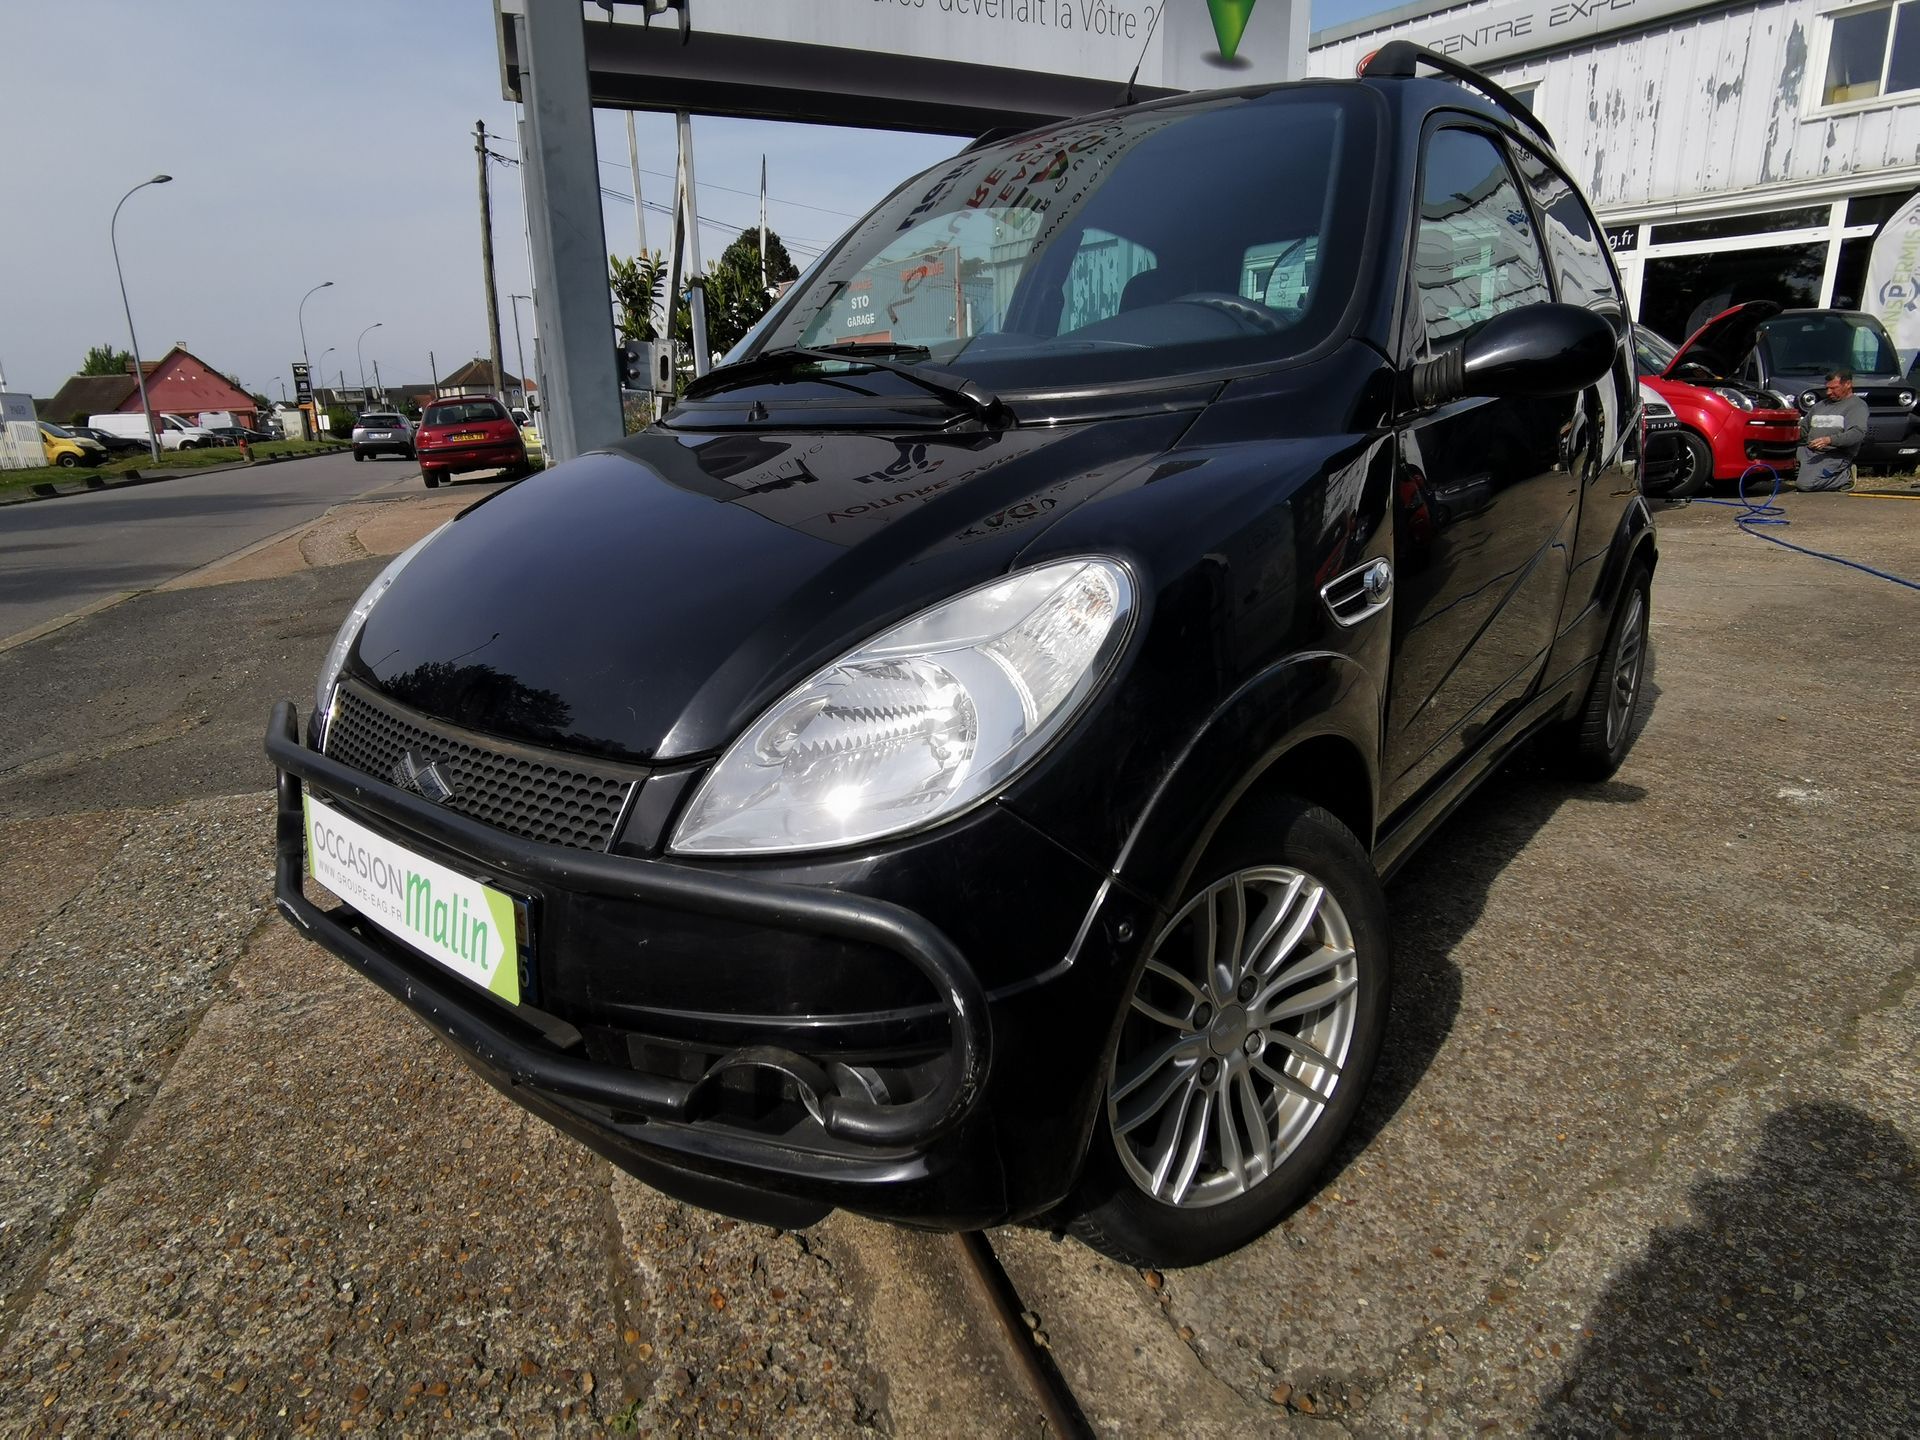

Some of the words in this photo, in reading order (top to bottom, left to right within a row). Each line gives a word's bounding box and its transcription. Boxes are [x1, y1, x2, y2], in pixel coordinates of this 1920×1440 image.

[1053, 0, 1072, 29] la
[1080, 0, 1137, 39] Vôtre
[1427, 14, 1534, 55] CENTRE
[847, 313, 875, 328] GARAGE
[851, 295, 869, 309] STO
[314, 820, 404, 901] OCCASION
[317, 859, 404, 924] WWW.GROUPE-EAG.FR
